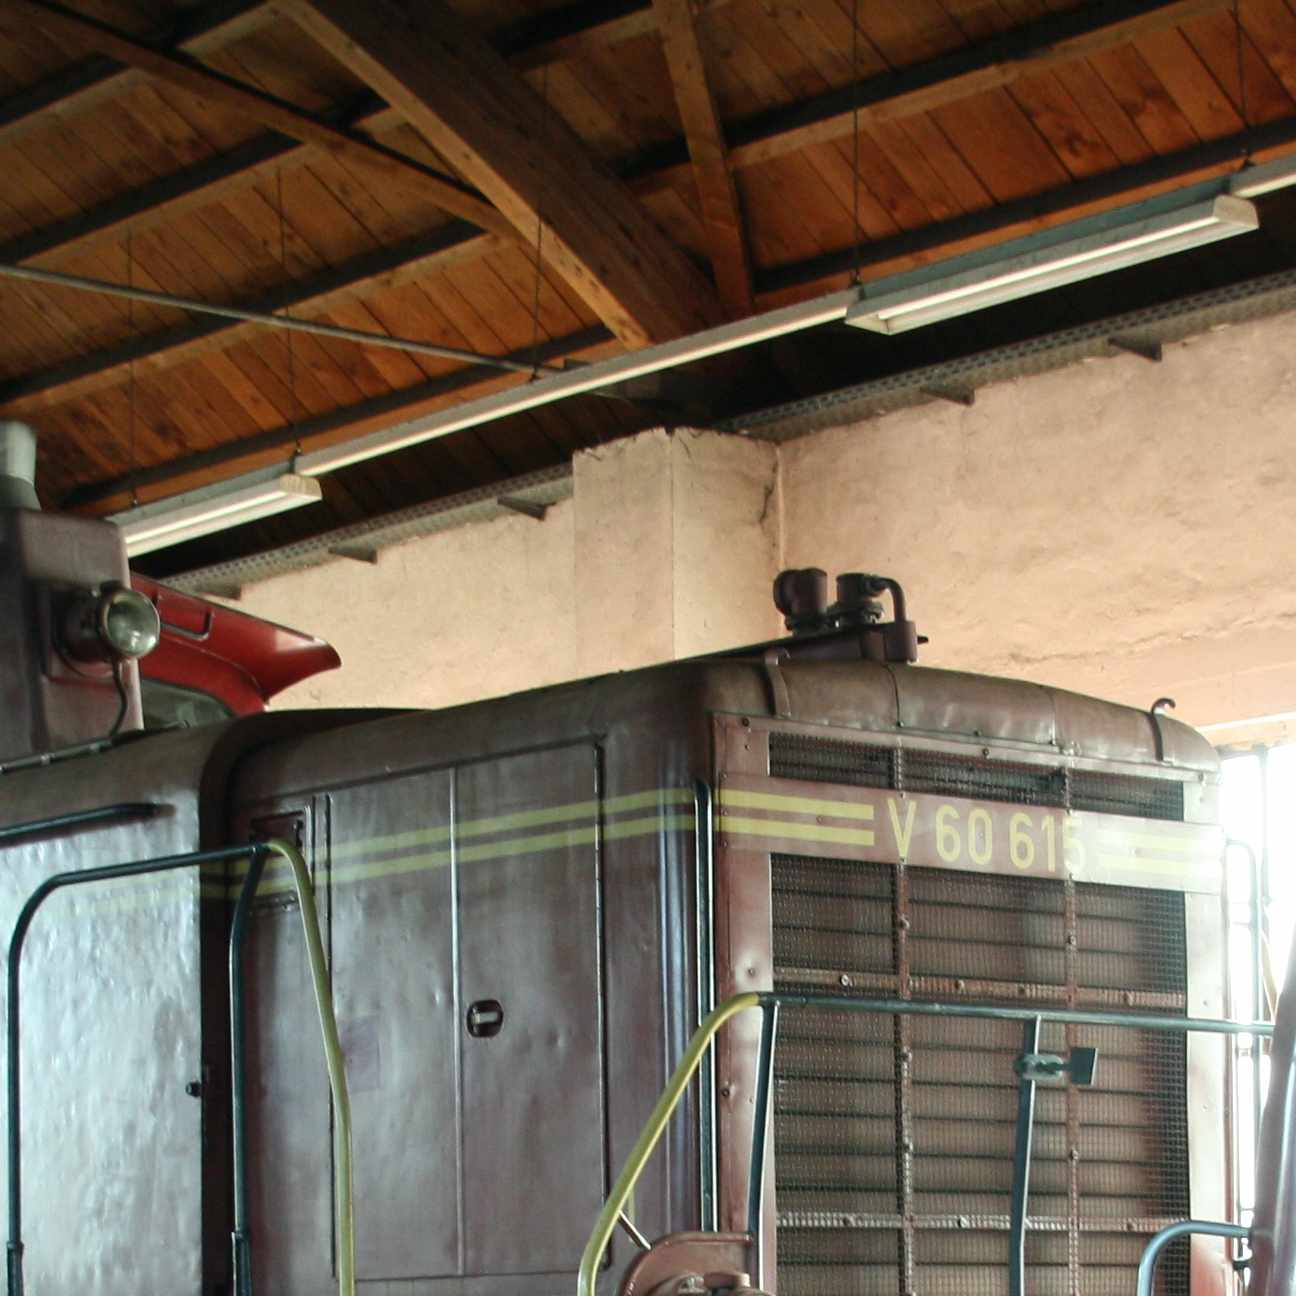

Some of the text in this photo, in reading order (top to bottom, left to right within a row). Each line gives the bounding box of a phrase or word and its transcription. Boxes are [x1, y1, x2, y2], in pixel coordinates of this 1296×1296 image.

[887, 798, 1086, 874] V 60 615
